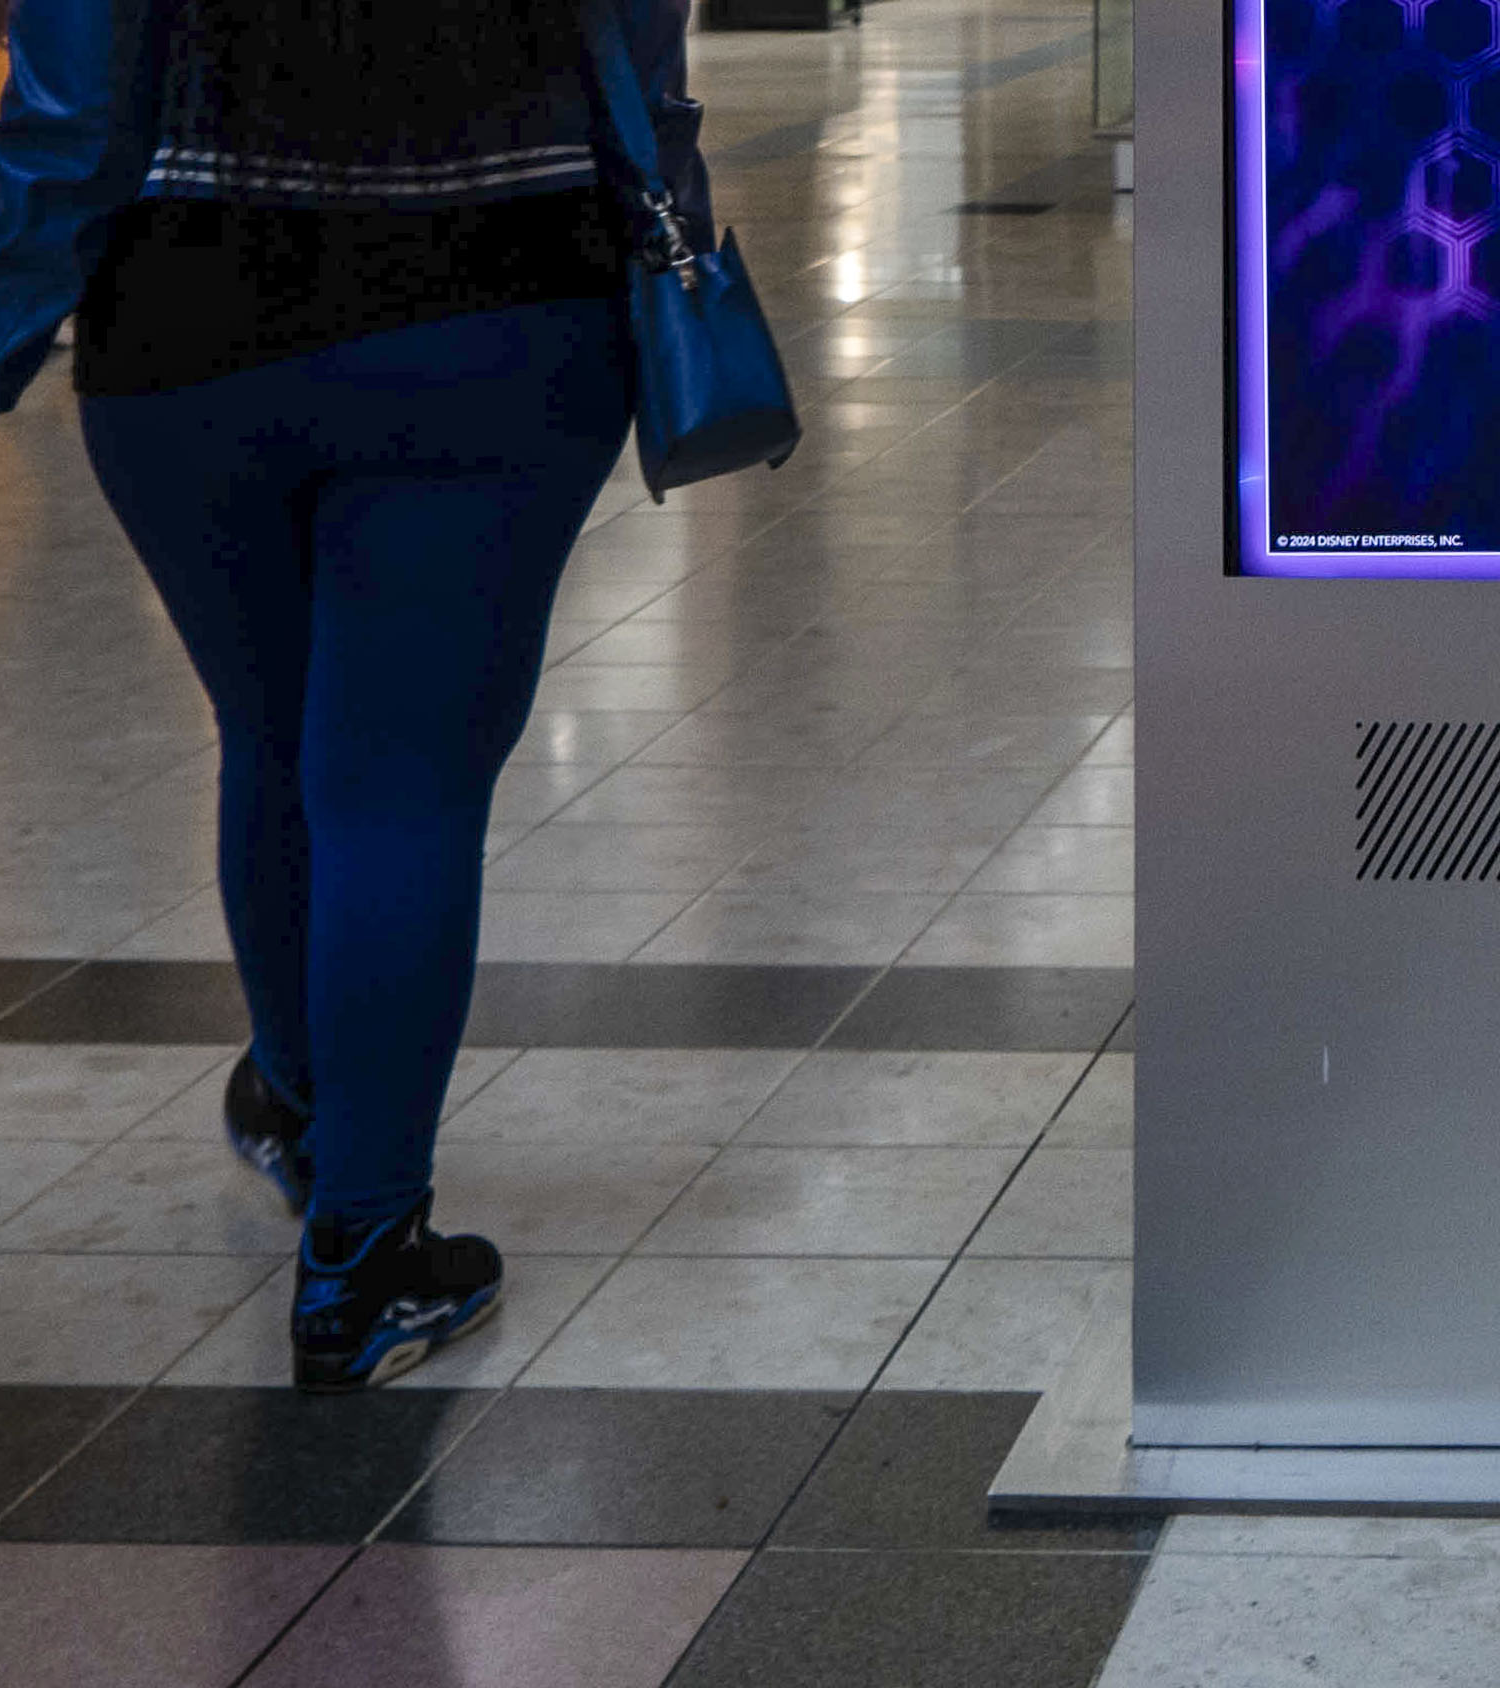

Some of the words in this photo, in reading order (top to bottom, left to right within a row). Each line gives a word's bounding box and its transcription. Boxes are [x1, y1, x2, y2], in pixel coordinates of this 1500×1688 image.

[1290, 535, 1315, 547] 2024
[1317, 535, 1359, 547] DISNEY
[1361, 535, 1437, 548] ENTERPRISES,
[1439, 535, 1464, 547] INC.
